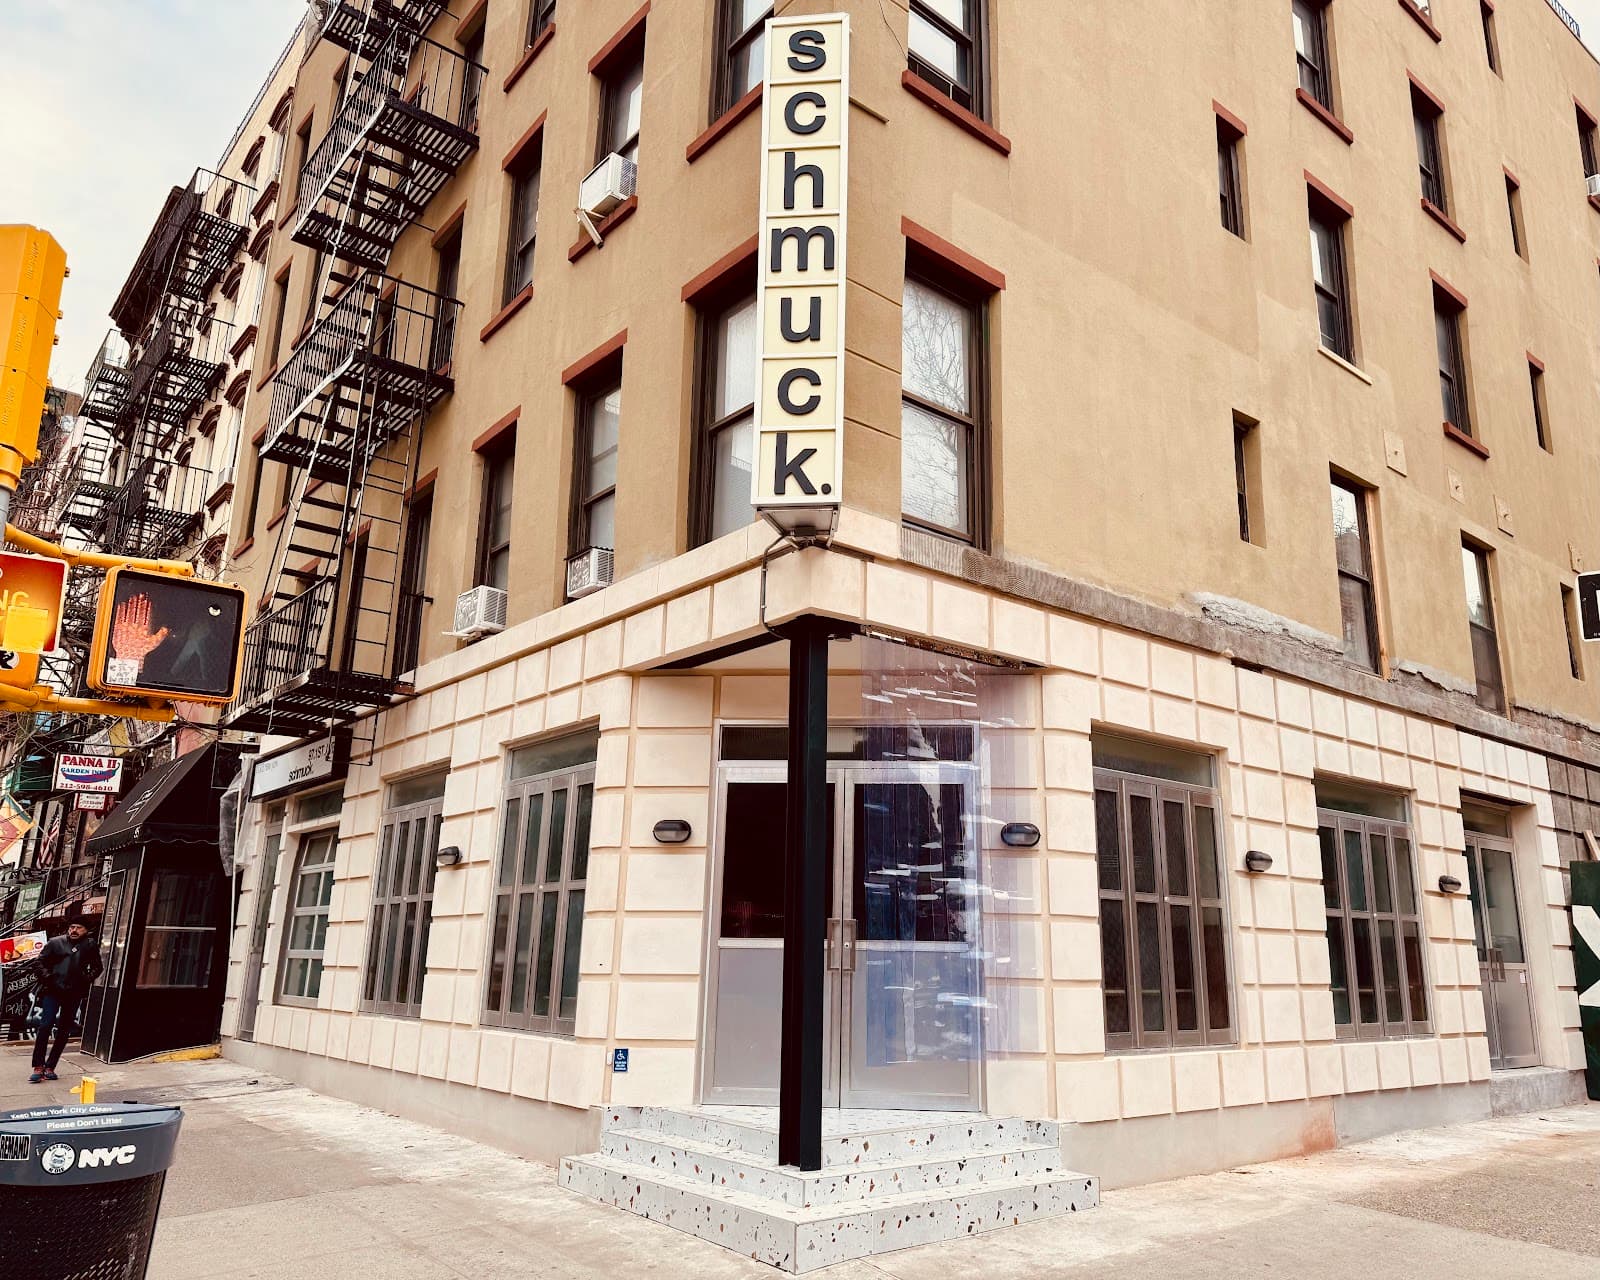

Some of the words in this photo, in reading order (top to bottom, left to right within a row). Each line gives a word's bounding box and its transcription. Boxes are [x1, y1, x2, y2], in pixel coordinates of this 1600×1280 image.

[770, 30, 835, 496] schmuck.
[62, 755, 103, 768] PANNA
[10, 1112, 30, 1120] Keep
[30, 1110, 48, 1118] New
[49, 1107, 68, 1115] York
[70, 1106, 87, 1115] City
[46, 1121, 75, 1129] Please
[76, 1119, 99, 1128] Don't
[101, 1117, 123, 1125] Litter
[78, 1145, 136, 1168] NYC
